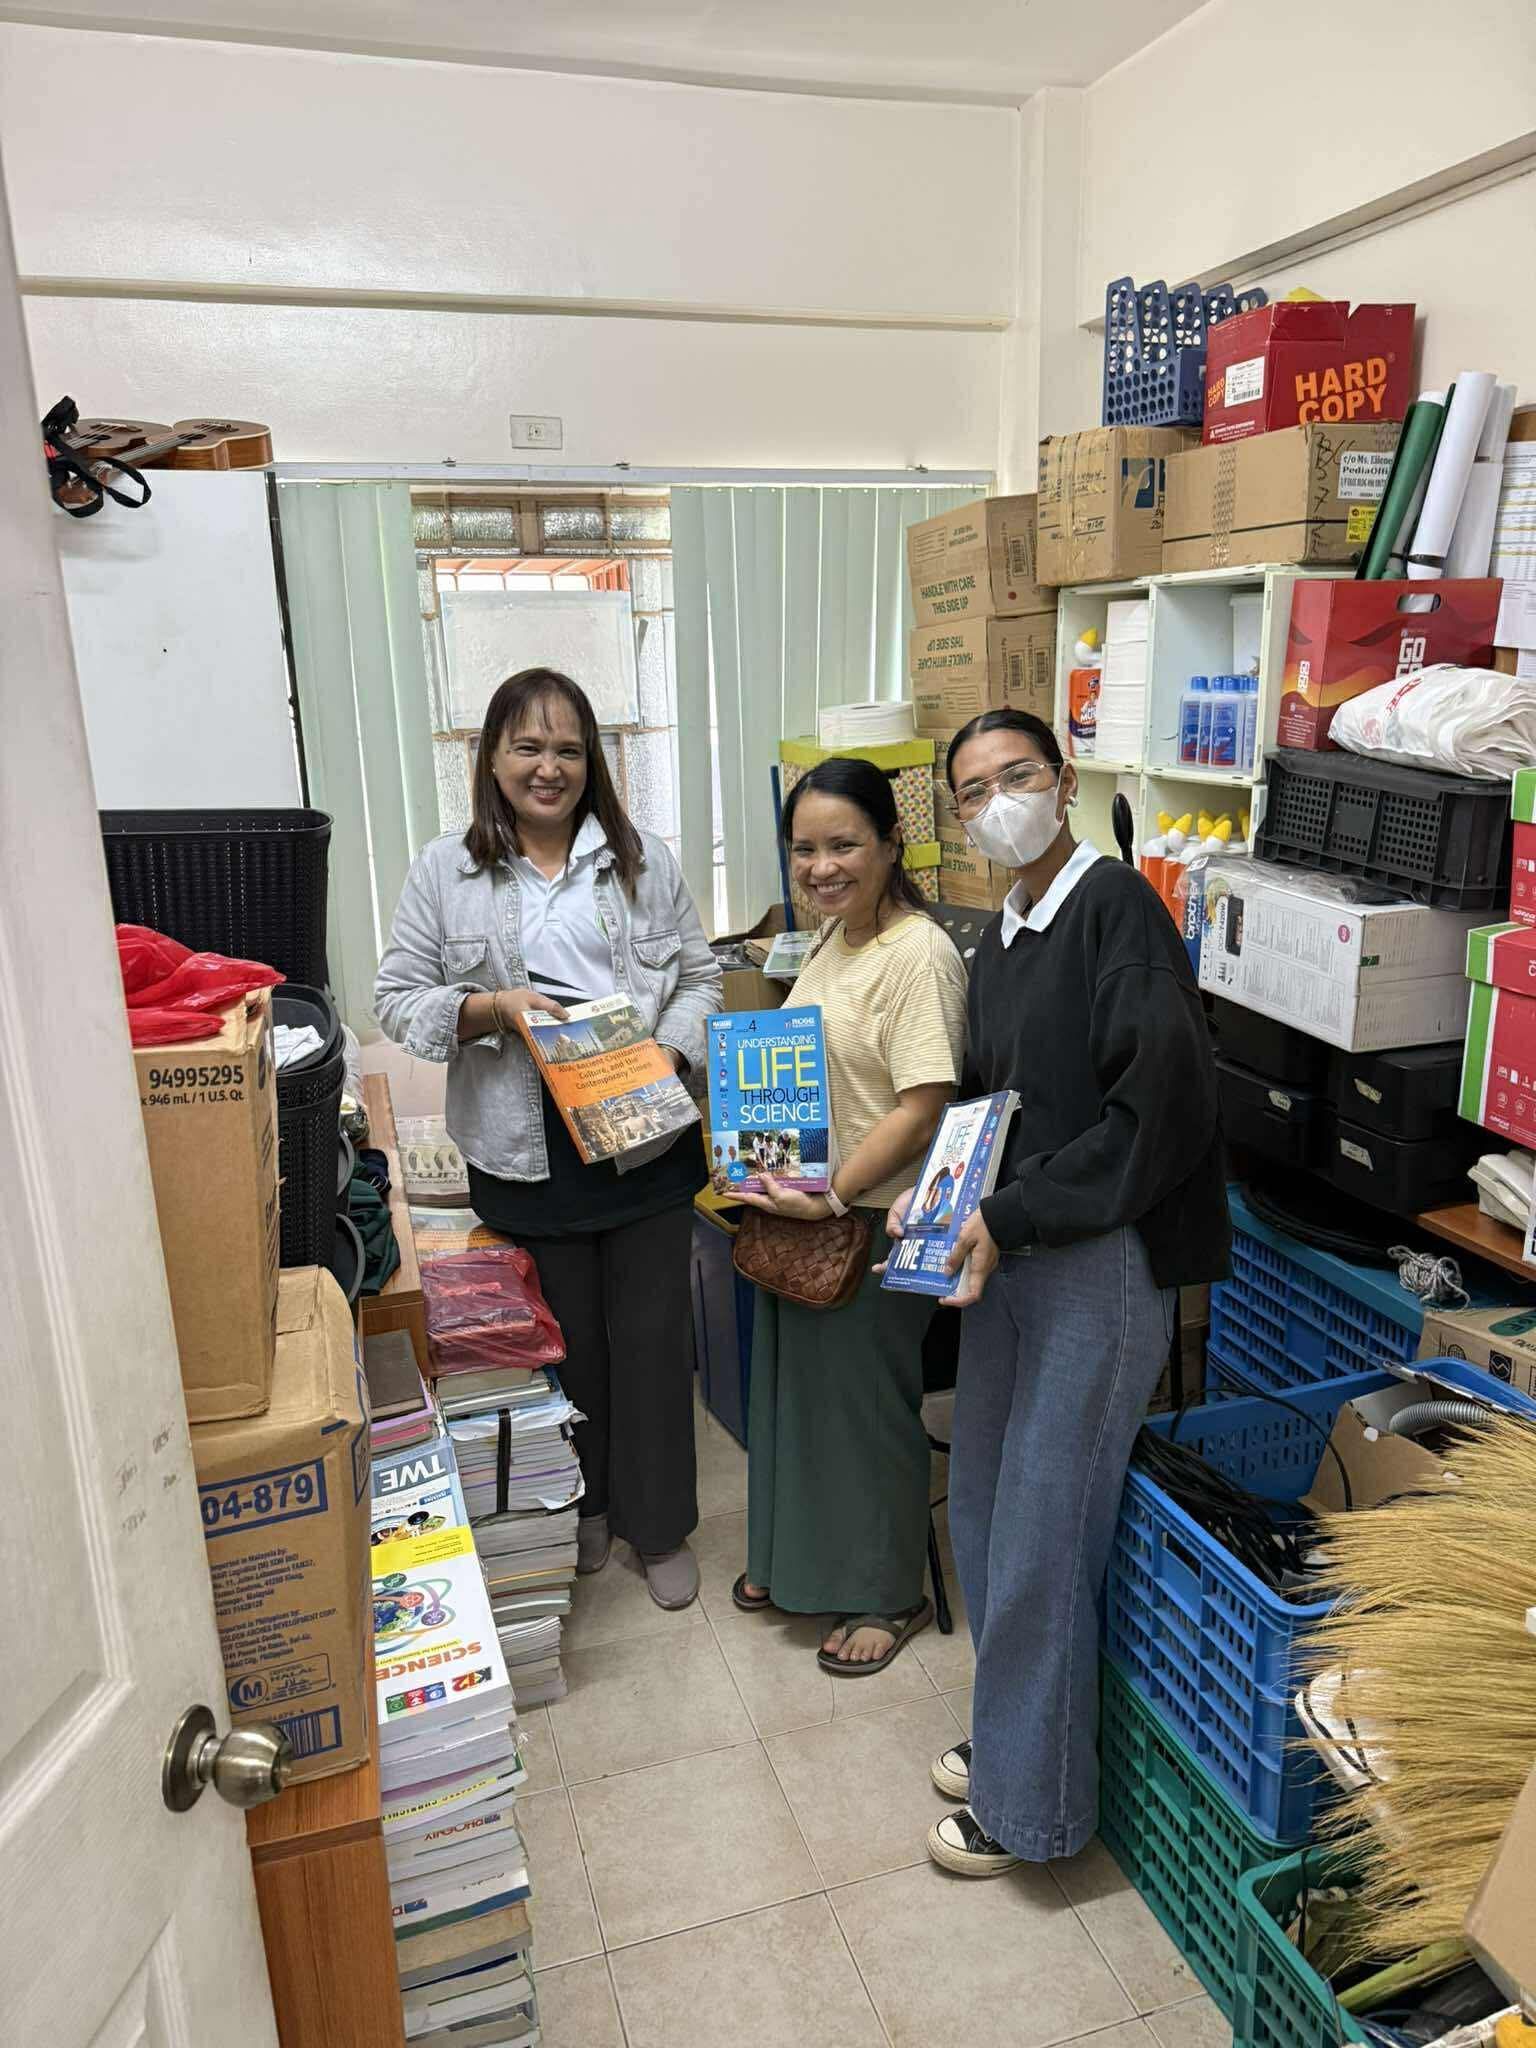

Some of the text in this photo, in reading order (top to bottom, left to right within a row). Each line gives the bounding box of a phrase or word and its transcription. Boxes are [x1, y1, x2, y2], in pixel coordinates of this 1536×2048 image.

[1295, 357, 1387, 402] HARD
[1298, 383, 1388, 426] COPY
[920, 575, 976, 600] HANDLE WITH CARE
[932, 596, 969, 616] THIS SIDE UP
[927, 635, 964, 652] THIS SIDE UP
[1398, 637, 1427, 663] GO
[918, 658, 932, 670] CARE
[948, 652, 973, 667] HANDLE
[1185, 878, 1199, 940] brother
[748, 1019, 758, 1033] 4
[737, 1033, 817, 1049] UNDERSTANDING
[148, 1064, 245, 1090] 94995295
[737, 1044, 820, 1091] LIFE
[148, 1093, 171, 1106] 946
[172, 1093, 190, 1105] mL
[199, 1092, 206, 1104] 1
[207, 1090, 228, 1103] U.S.
[743, 1086, 820, 1105] THROUGH
[739, 1102, 822, 1124] SCIENCE
[894, 1239, 925, 1270] TWE
[379, 1454, 447, 1492] TWE
[201, 1473, 313, 1526] 04-879
[375, 1641, 482, 1682] SCIENCE
[242, 1680, 263, 1702] M
